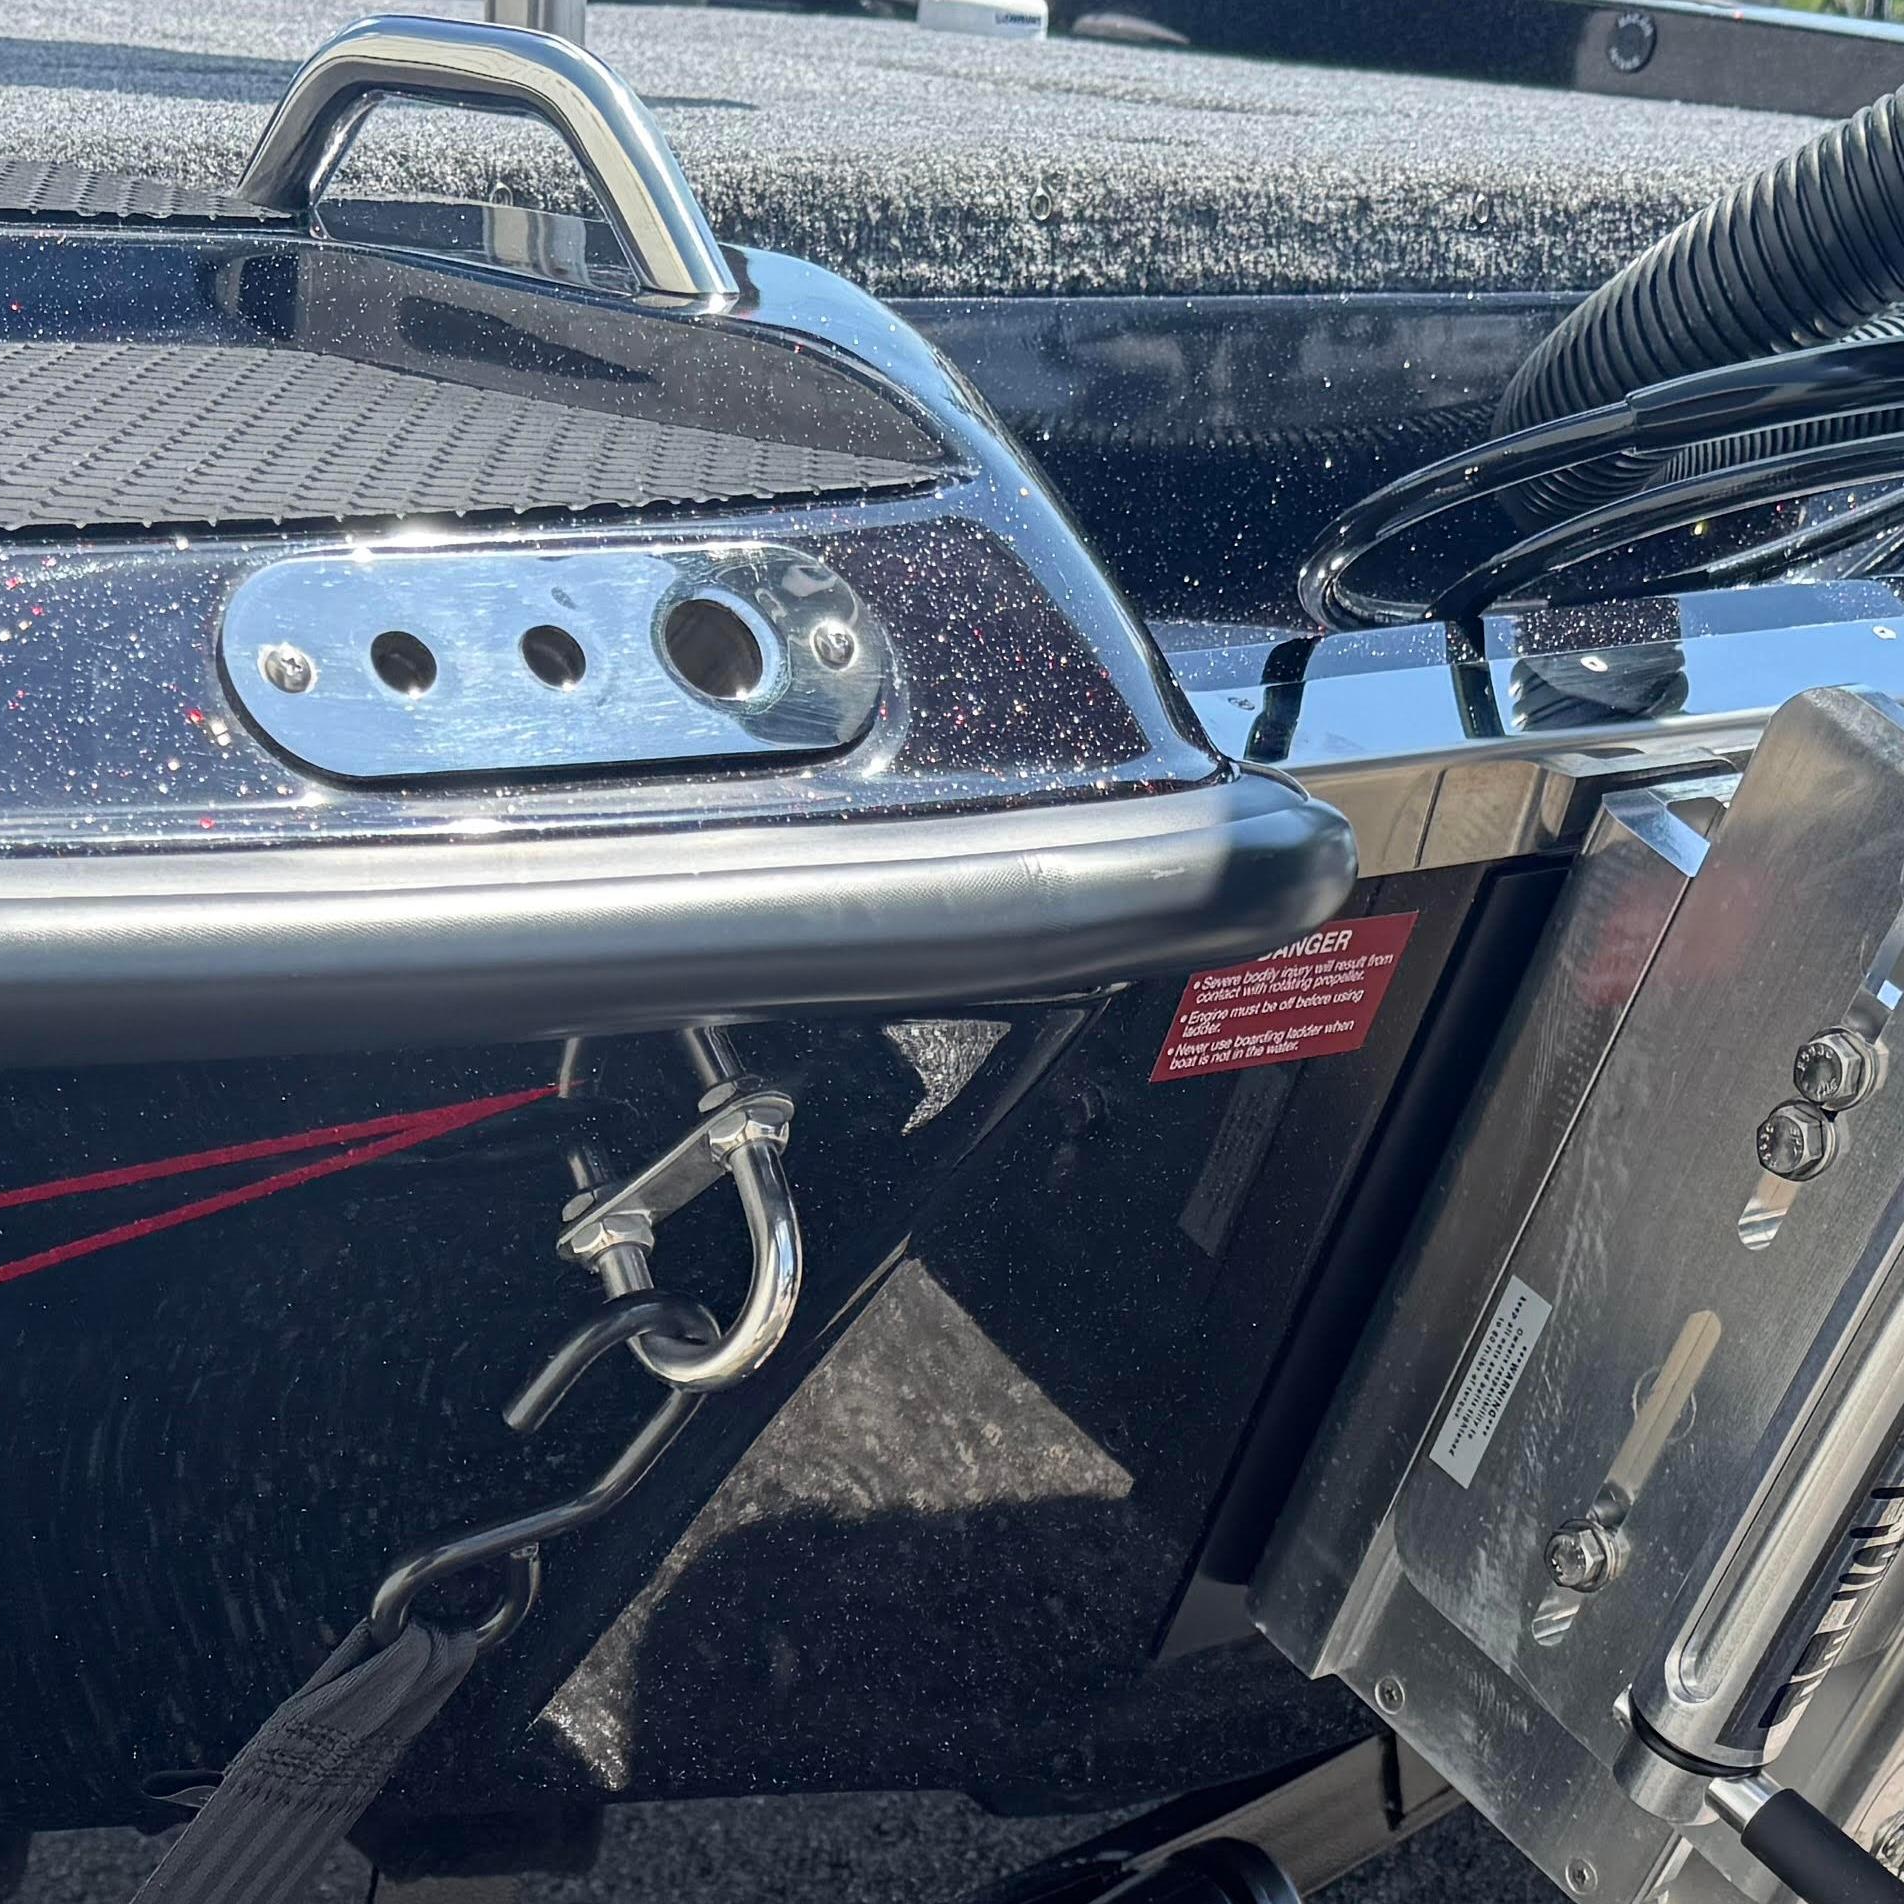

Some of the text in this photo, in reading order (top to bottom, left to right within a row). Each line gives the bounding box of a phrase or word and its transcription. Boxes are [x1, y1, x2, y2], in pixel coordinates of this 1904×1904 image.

[1257, 930, 1353, 961] ANGER
[1201, 954, 1394, 990] Severe bodily injury will result from
[1196, 988, 1241, 1004] contact
[1243, 983, 1267, 997] with
[1268, 977, 1313, 993] rotating
[1187, 989, 1364, 1025] Engine must be off before using
[1175, 1020, 1355, 1057] Never use boarding ladder when
[1182, 1022, 1221, 1038] ladder.
[1169, 1041, 1299, 1070] boat is not in the water.
